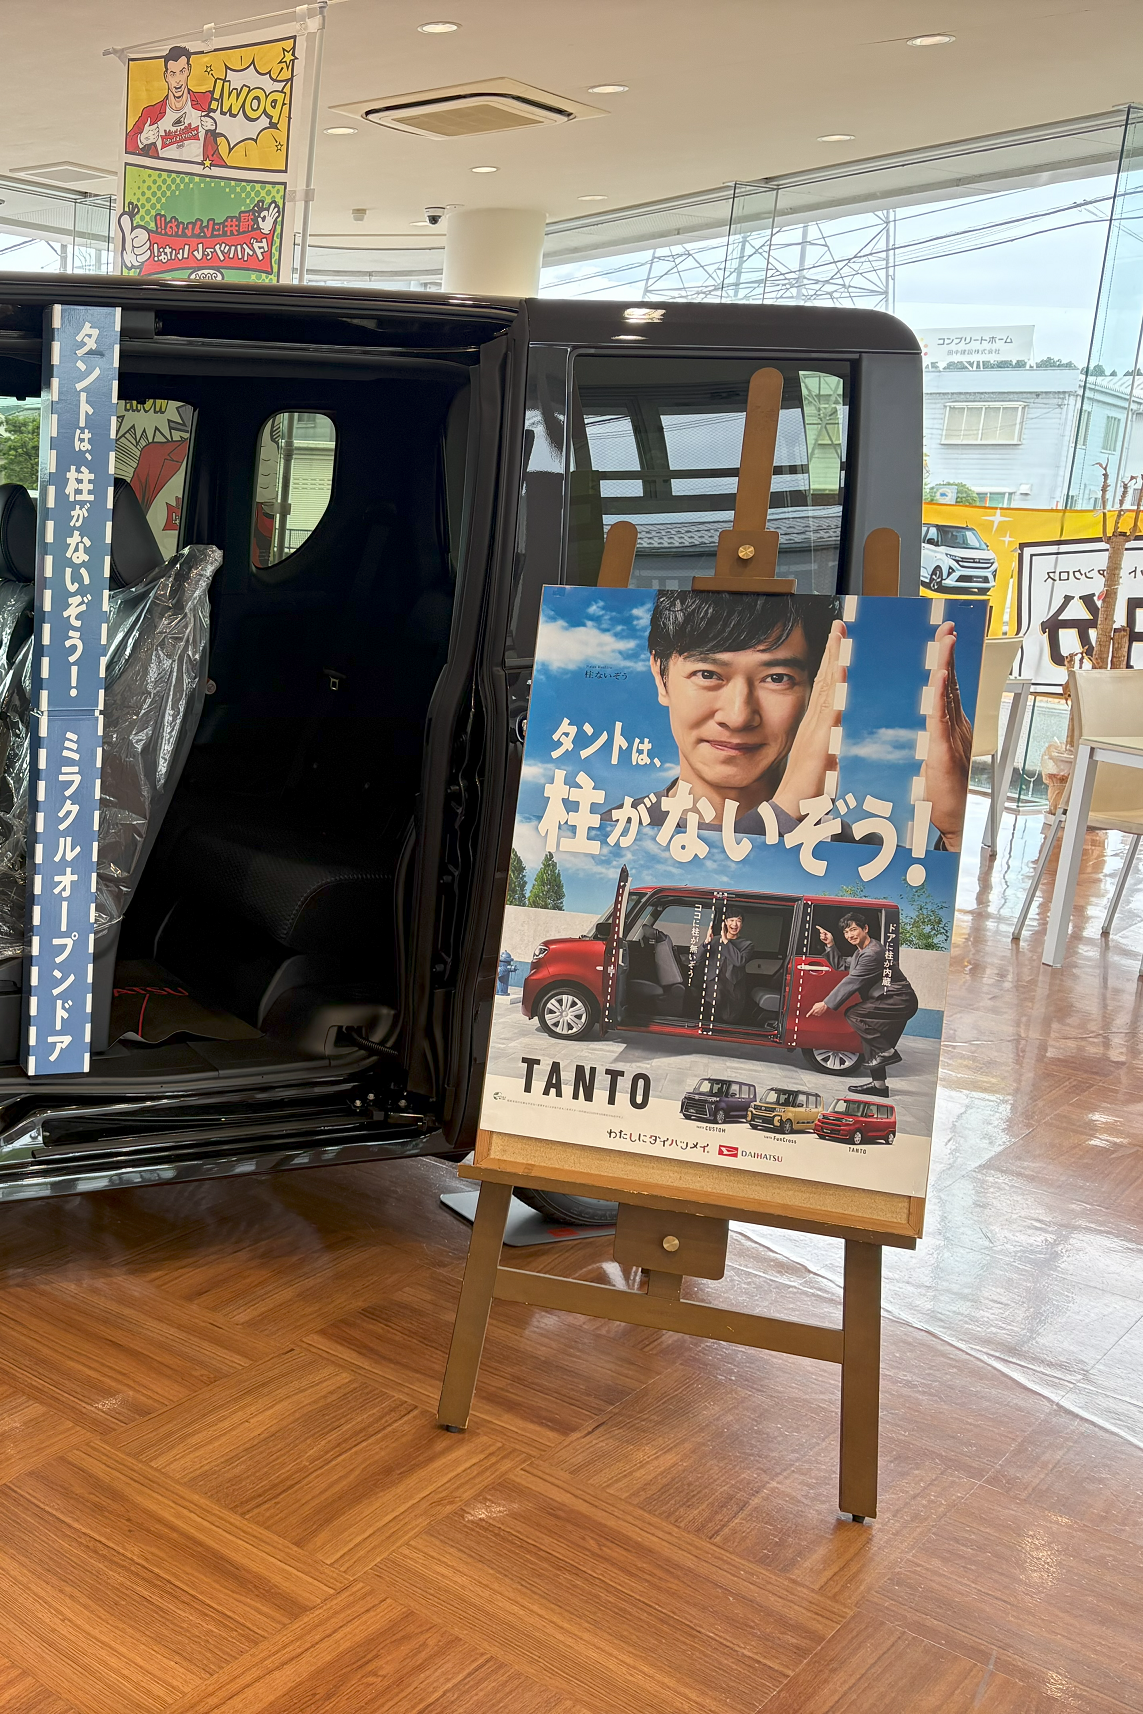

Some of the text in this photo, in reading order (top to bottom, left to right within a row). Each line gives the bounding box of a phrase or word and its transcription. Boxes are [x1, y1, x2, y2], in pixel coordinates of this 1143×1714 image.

[937, 335, 1013, 346] コンプリートホーム
[63, 321, 101, 697] タントは、柱がないぞう！
[550, 717, 661, 768] タントは、
[538, 769, 933, 887] 柱がないぞう！
[47, 731, 82, 1062] ミラクルオープンドア
[521, 1056, 652, 1110] TANTO
[705, 1125, 726, 1133] CUSTOM
[773, 1136, 797, 1144] FunCross
[741, 1150, 783, 1162] DAIHATSU
[848, 1146, 867, 1155] TANTO
